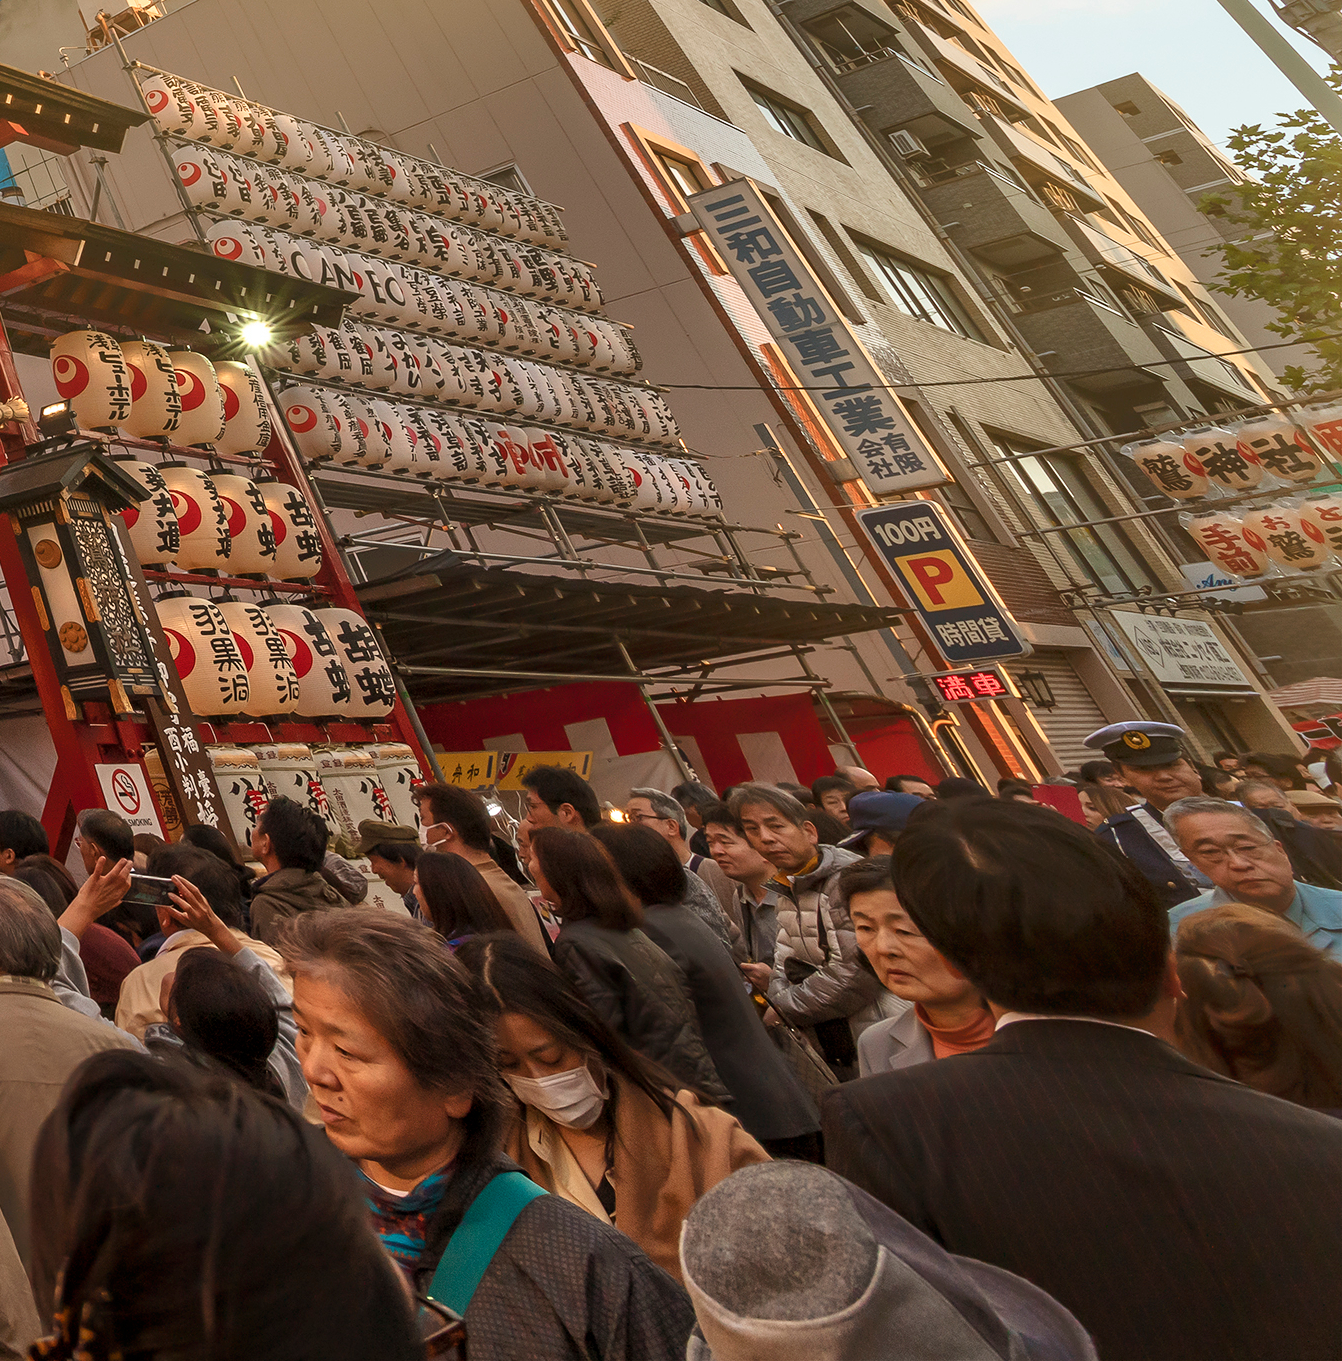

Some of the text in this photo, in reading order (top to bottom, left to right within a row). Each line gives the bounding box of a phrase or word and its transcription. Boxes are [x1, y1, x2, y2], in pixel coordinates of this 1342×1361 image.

[703, 193, 897, 438] 三和自動車工業
[873, 517, 944, 549] 100円
[914, 555, 957, 606] P
[934, 616, 1011, 649] 時間貸
[189, 603, 250, 705] 羽黒洞
[936, 670, 1007, 701] 満車
